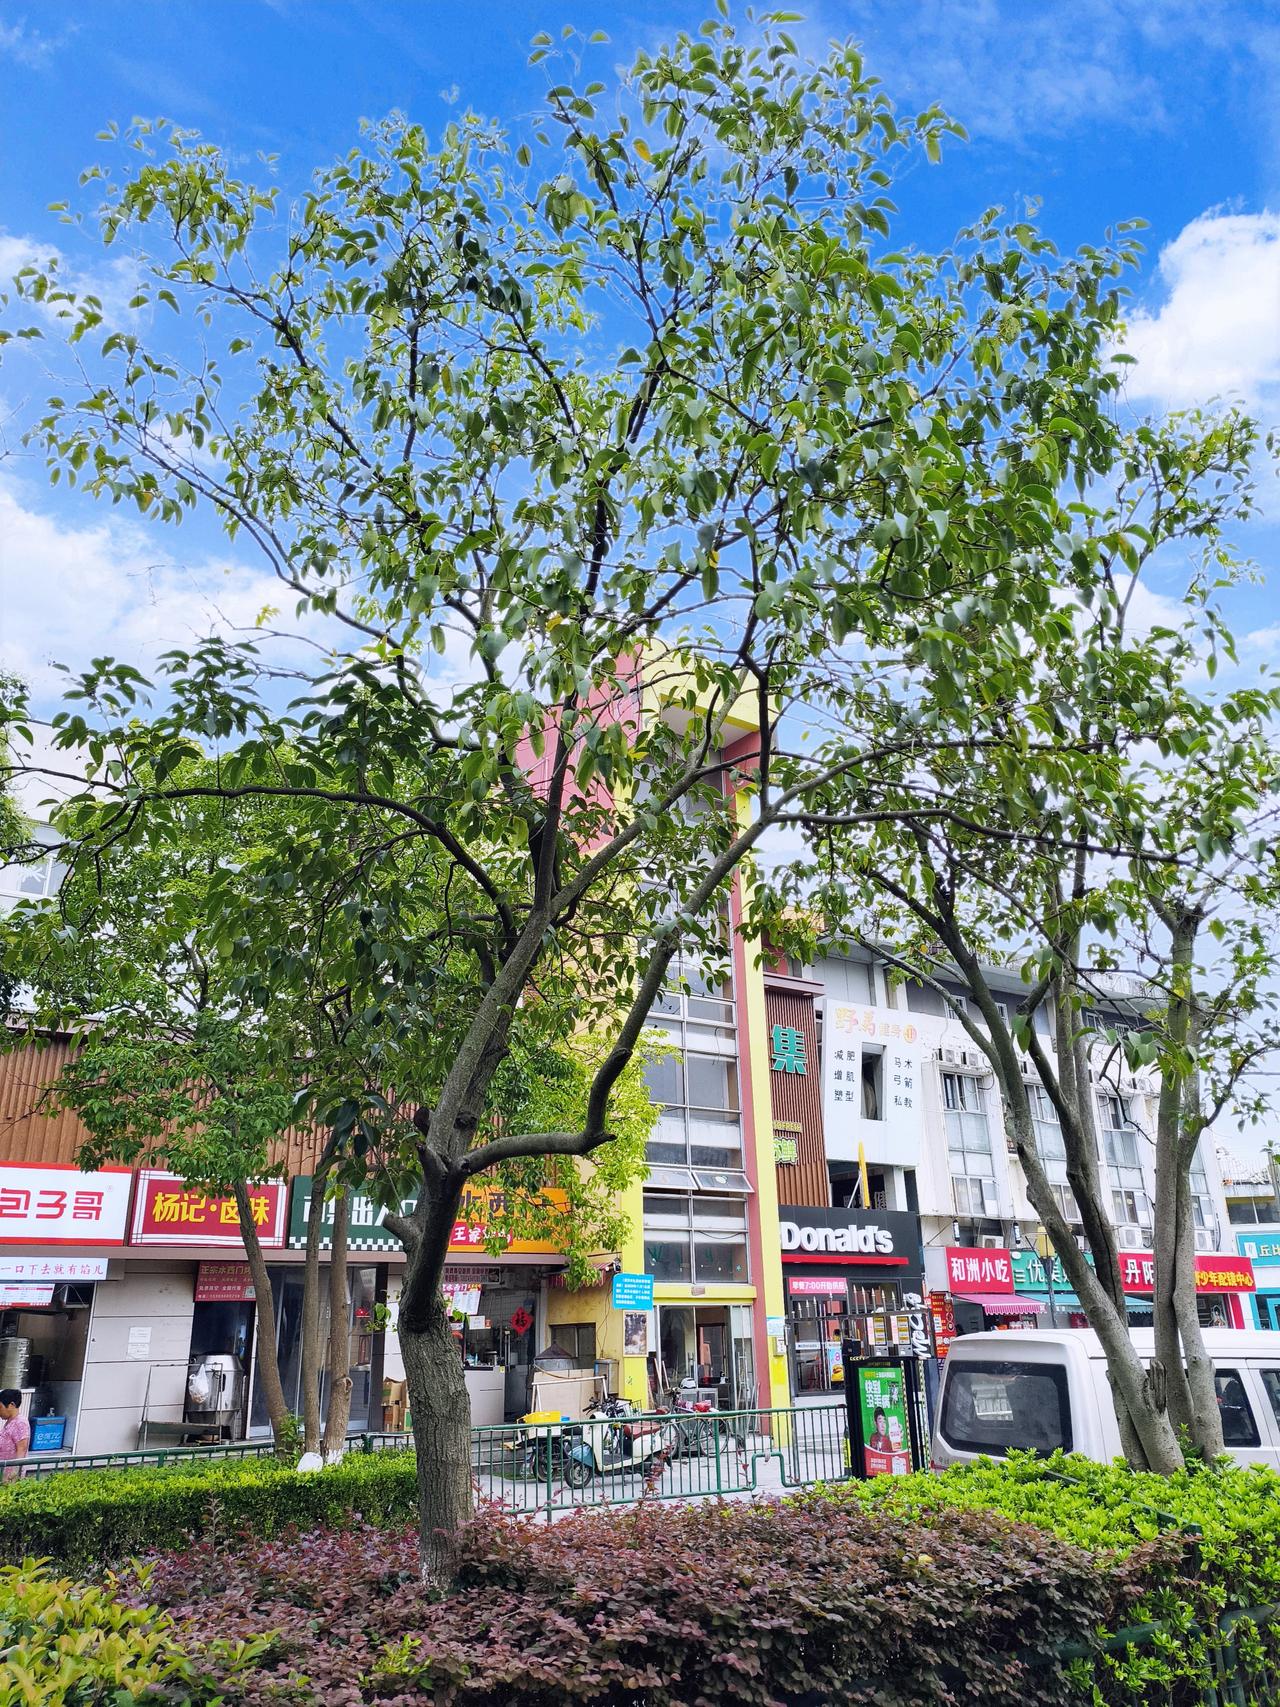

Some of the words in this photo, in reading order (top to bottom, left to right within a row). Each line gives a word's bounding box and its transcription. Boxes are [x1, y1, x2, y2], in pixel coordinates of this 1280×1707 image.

[771, 1024, 807, 1075] 集
[0, 1188, 104, 1220] 包子哥
[0, 1263, 104, 1276] 一口下去就有馅儿
[951, 1257, 1010, 1282] 和洲小吃
